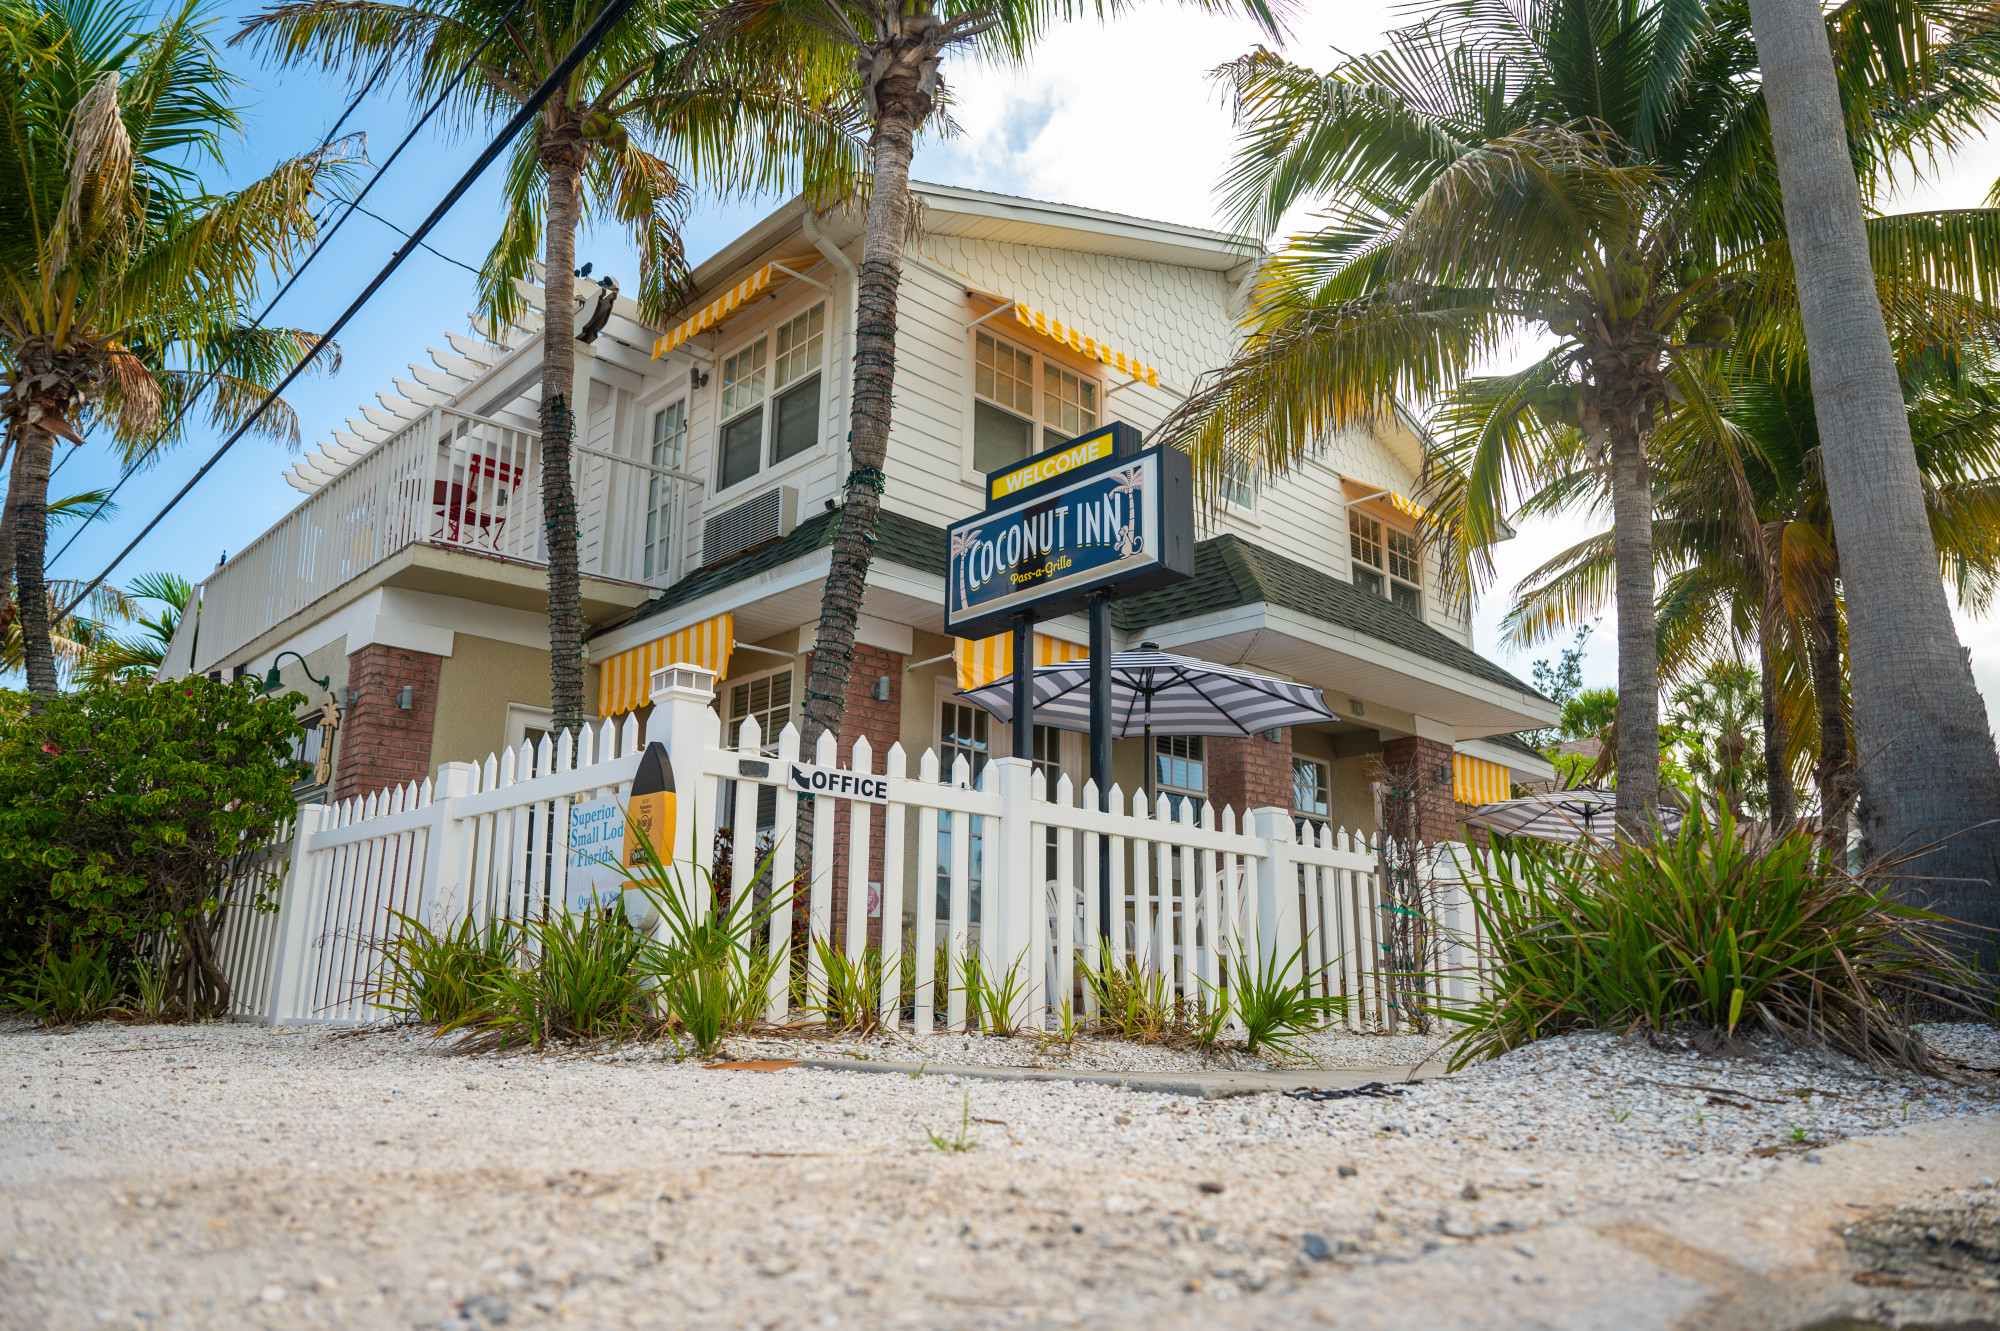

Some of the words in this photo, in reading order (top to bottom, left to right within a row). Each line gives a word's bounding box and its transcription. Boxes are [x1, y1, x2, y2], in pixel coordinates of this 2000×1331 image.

[1005, 441, 1100, 493] WELCOME
[968, 505, 1069, 591] COCONUT
[1077, 492, 1122, 547] INN
[1010, 554, 1072, 586] Pass-a-Grille
[811, 771, 888, 799] OFFICE
[572, 804, 616, 829] Superior
[570, 826, 599, 848] Small
[577, 845, 614, 868] Florida
